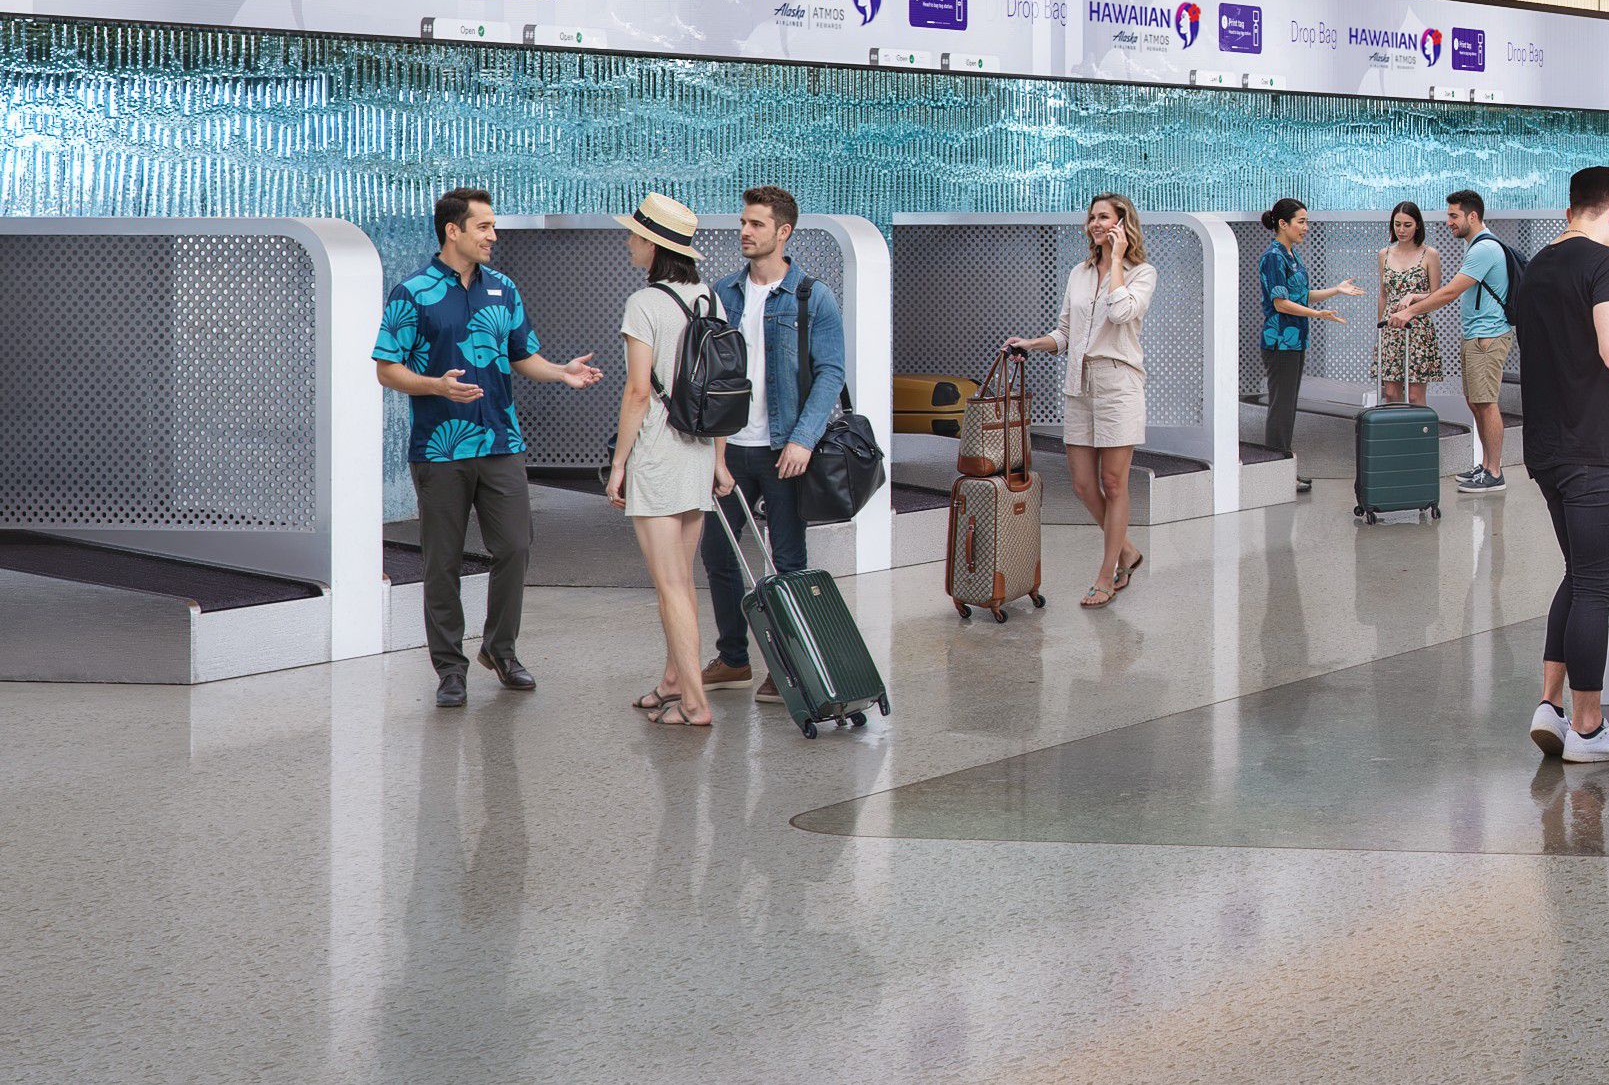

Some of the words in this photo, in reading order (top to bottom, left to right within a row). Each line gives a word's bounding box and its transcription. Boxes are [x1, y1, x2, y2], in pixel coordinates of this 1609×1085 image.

[774, 2, 806, 19] Alaska
[813, 7, 845, 21] ATMOS
[1089, 0, 1171, 28] HAWAIIAN
[460, 25, 476, 36] Open
[559, 32, 574, 42] Open
[1113, 30, 1138, 44] Alaska
[1291, 20, 1315, 48] Drop
[1319, 21, 1337, 50] Bag
[1143, 34, 1170, 46] ATMOS
[1349, 27, 1417, 51] HAWAIIAN
[1507, 42, 1526, 66] Drop
[1529, 43, 1544, 67] Bag
